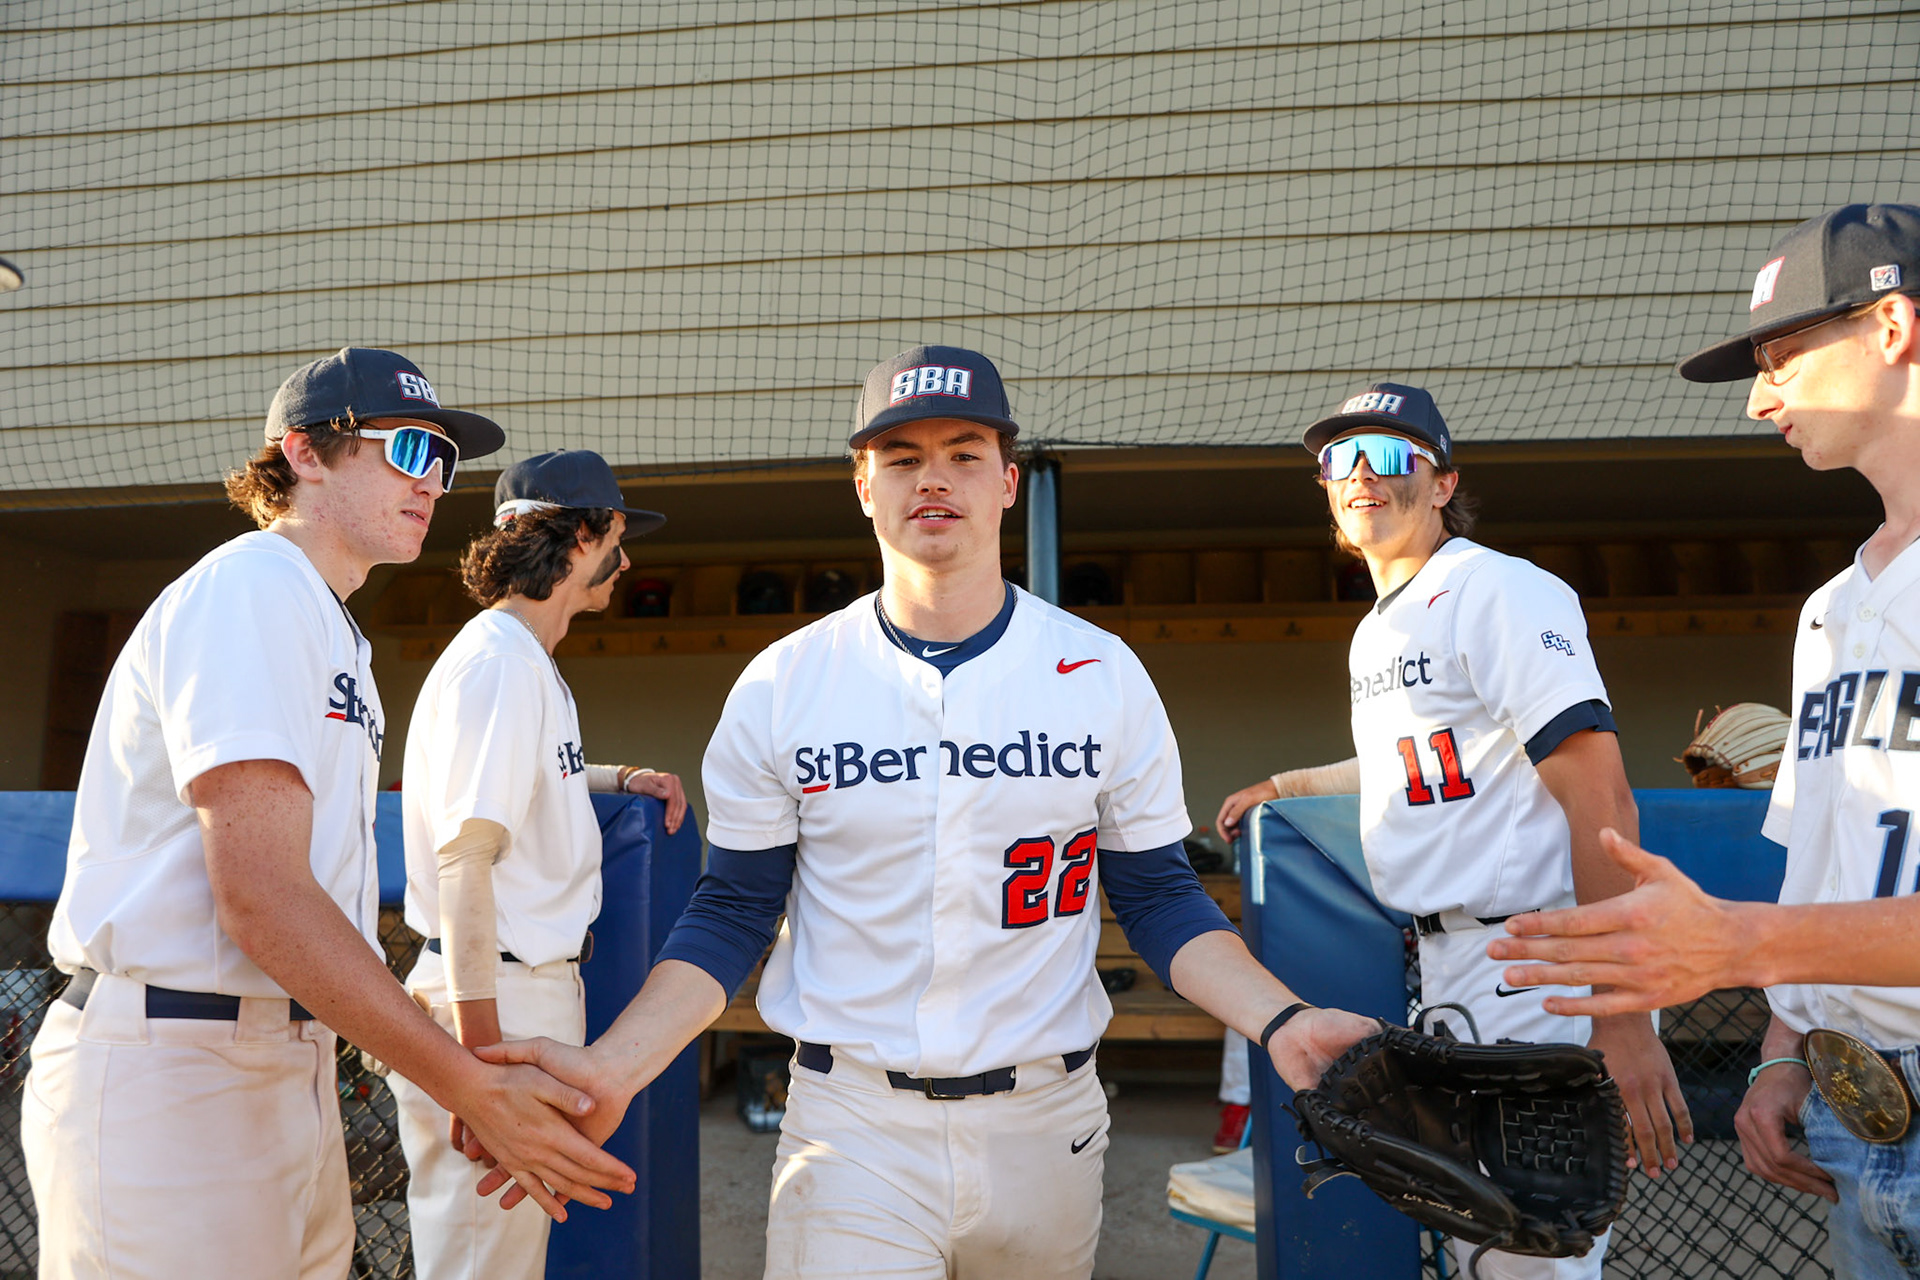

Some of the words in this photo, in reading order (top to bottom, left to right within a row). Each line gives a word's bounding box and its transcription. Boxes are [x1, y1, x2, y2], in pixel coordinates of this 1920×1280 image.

[890, 364, 973, 407] SBA
[1341, 391, 1407, 416] SBA
[1541, 630, 1576, 656] SBA
[1397, 727, 1476, 806] 11
[1001, 826, 1097, 929] 22
